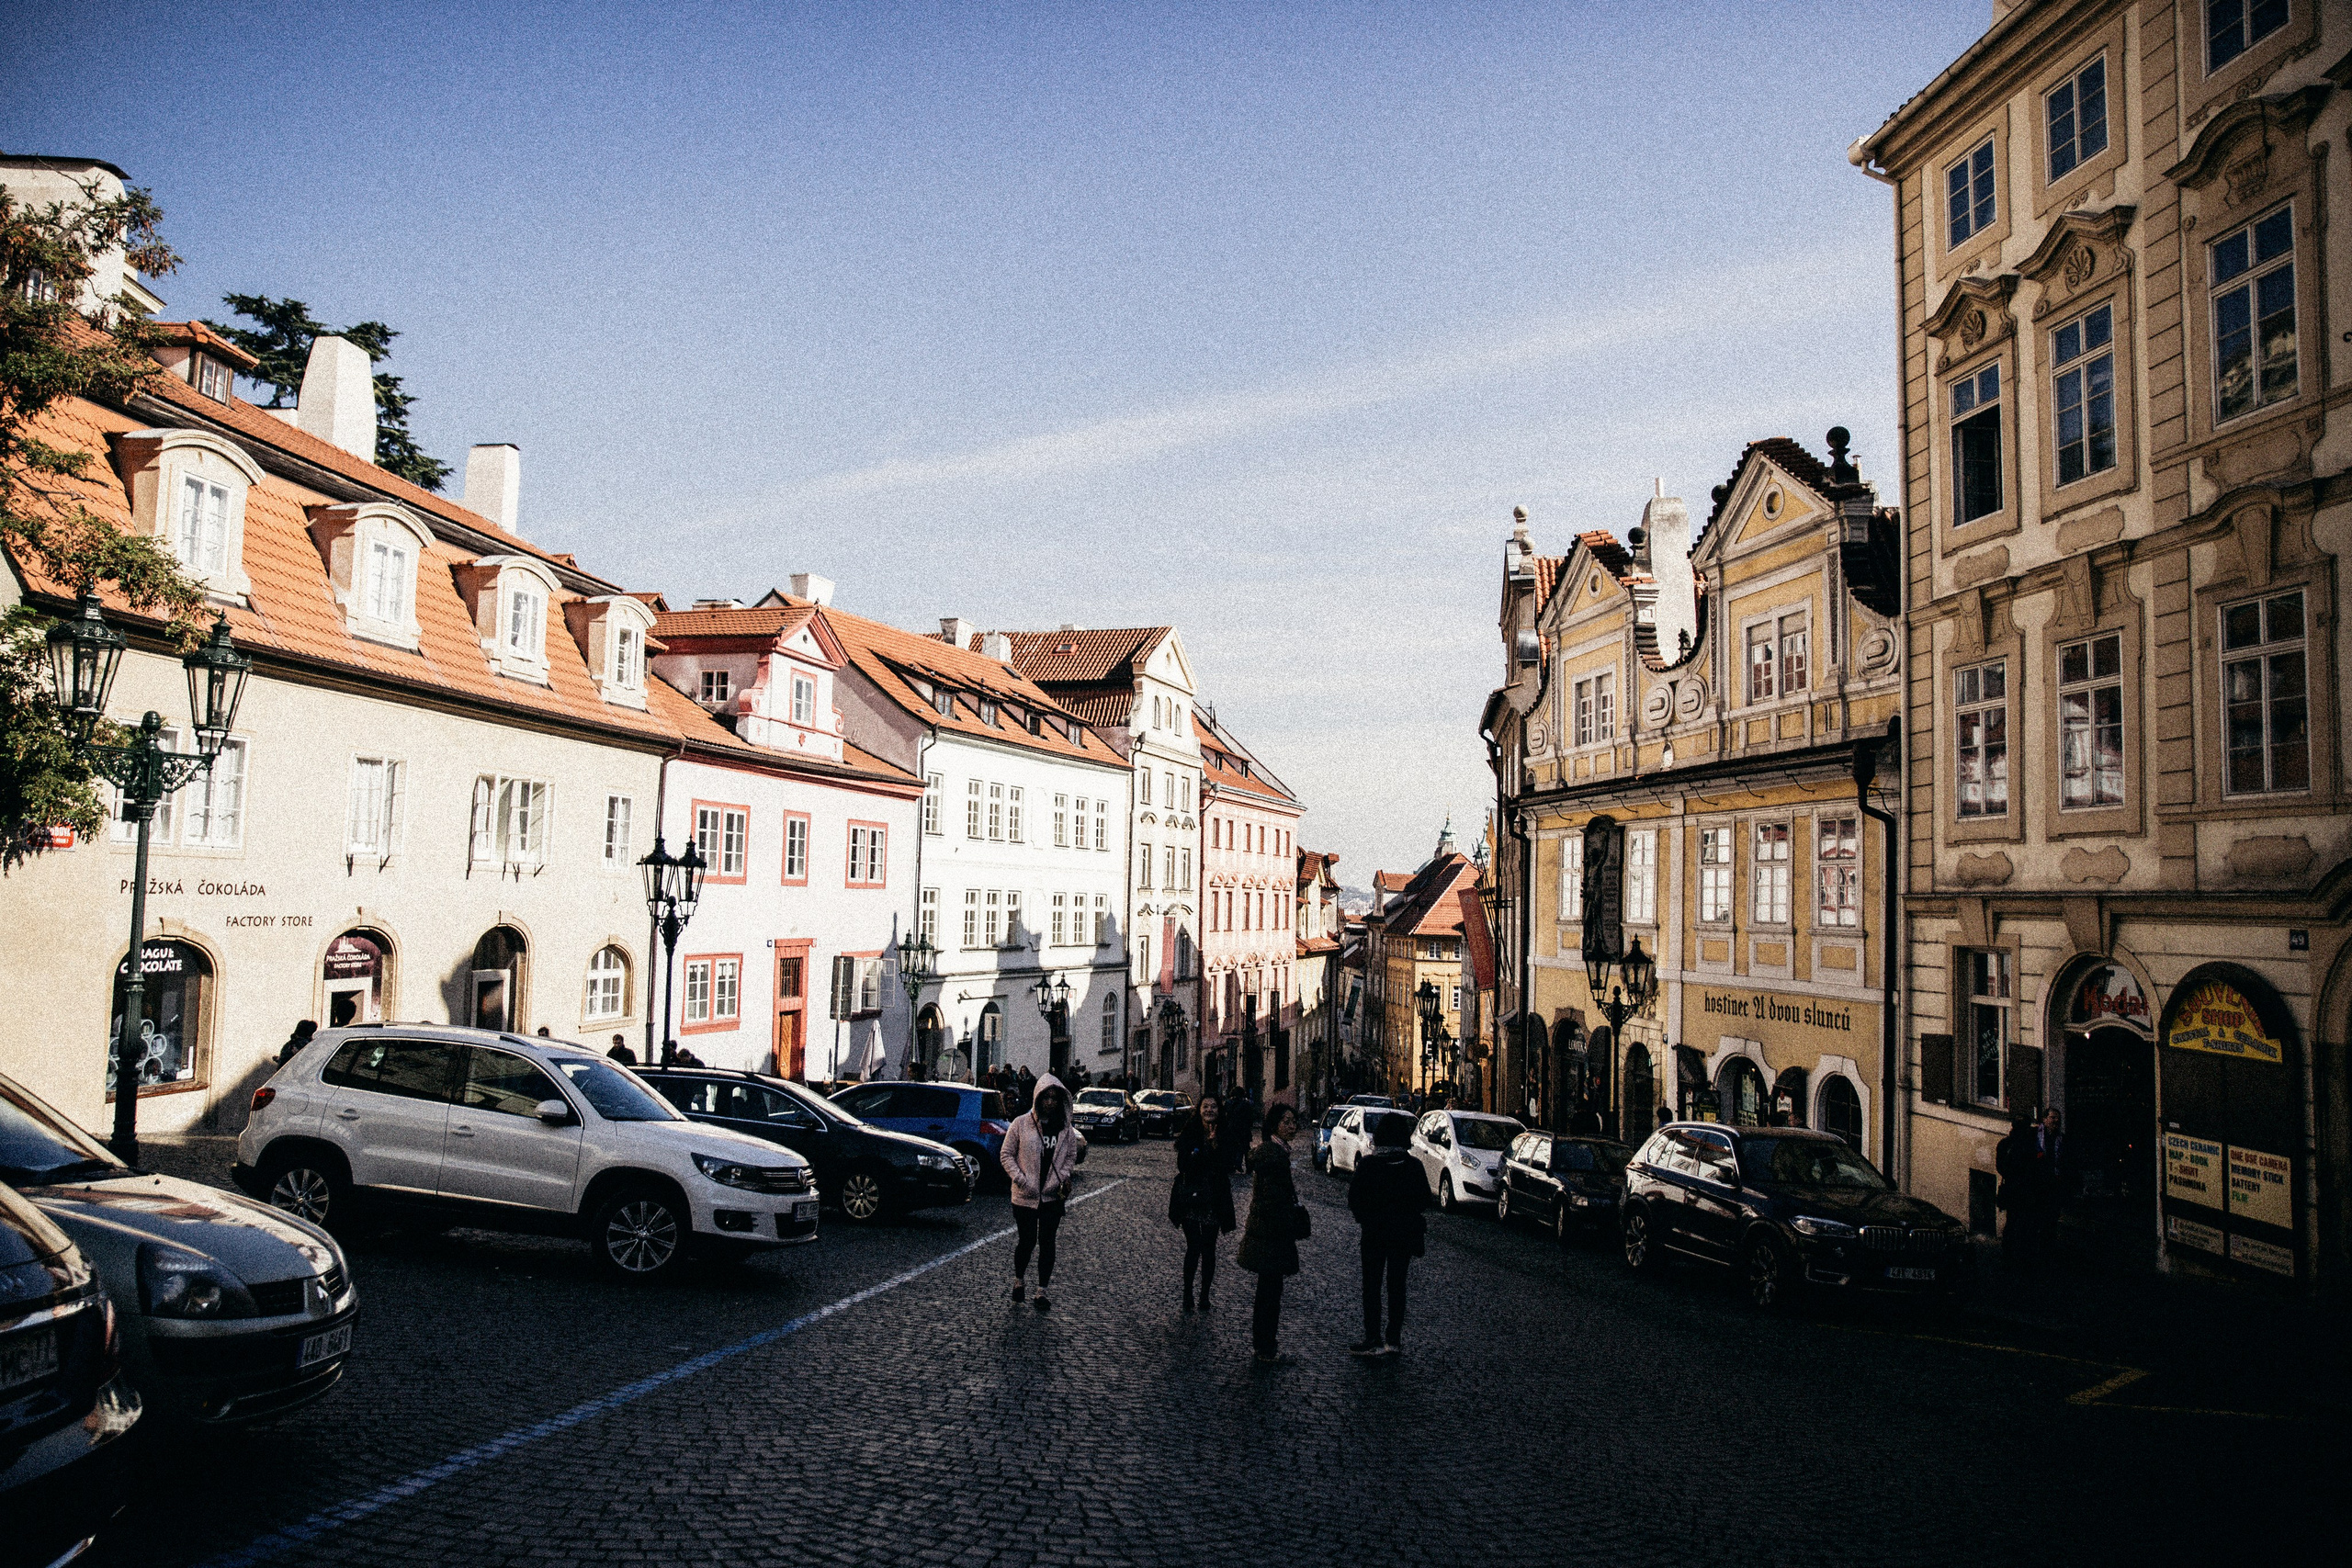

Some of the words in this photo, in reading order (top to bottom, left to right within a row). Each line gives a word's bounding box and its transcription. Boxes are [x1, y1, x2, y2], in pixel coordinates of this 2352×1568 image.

[120, 878, 184, 895] PRŽSKÁ
[198, 879, 266, 897] ČOKOLÁDA
[226, 915, 277, 928] FACTORY
[281, 916, 313, 928] STORE
[140, 947, 175, 960] RAGUE
[120, 959, 183, 975] COCOLATE
[1704, 991, 1749, 1018] hostinec
[1770, 996, 1801, 1024] dvou
[1804, 1000, 1850, 1032] slunců
[2201, 1008, 2245, 1028] SHOP
[2168, 1136, 2188, 1149] CZECH
[2168, 1149, 2184, 1161] MAP
[2190, 1154, 2209, 1167] BOOK
[2231, 1150, 2243, 1162] ONE
[2245, 1153, 2257, 1165] USE
[2259, 1156, 2288, 1171] CAMERA
[2169, 1174, 2207, 1192] PASHMINA
[2232, 1164, 2261, 1179] MEMORY
[2263, 1171, 2284, 1185] STICK
[2232, 1178, 2260, 1193] BATTERY
